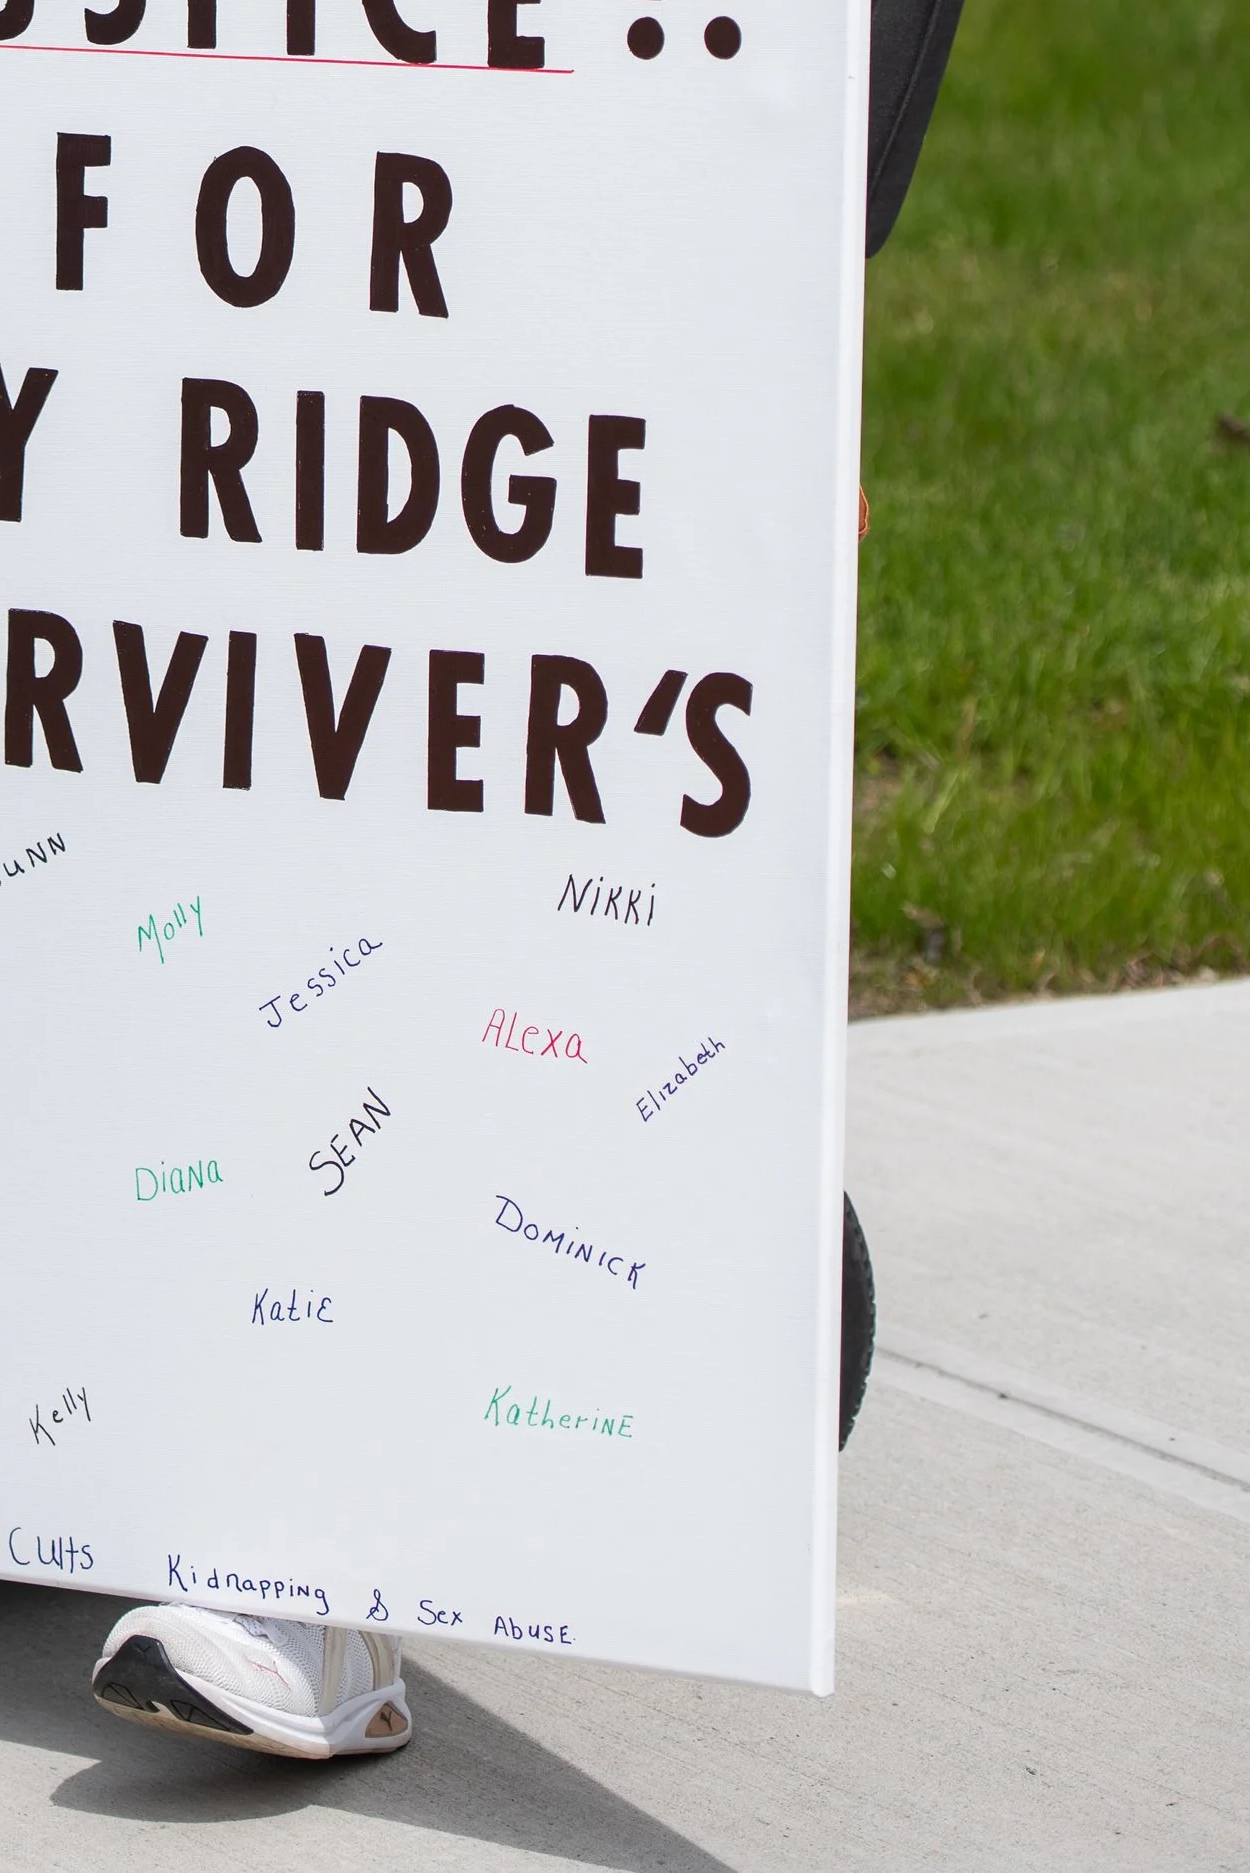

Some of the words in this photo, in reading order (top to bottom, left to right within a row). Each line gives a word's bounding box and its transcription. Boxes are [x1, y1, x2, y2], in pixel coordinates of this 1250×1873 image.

[55, 131, 454, 319] FOR
[179, 376, 647, 580] RIDGE
[137, 895, 204, 965] Molly
[258, 937, 384, 1029] Jessica
[635, 1036, 727, 1123] Elizabeth
[308, 1086, 392, 1197] SEAN
[495, 1194, 647, 1291] DOMINICK
[28, 1386, 92, 1447] Kelly
[416, 1599, 464, 1627] Sex
